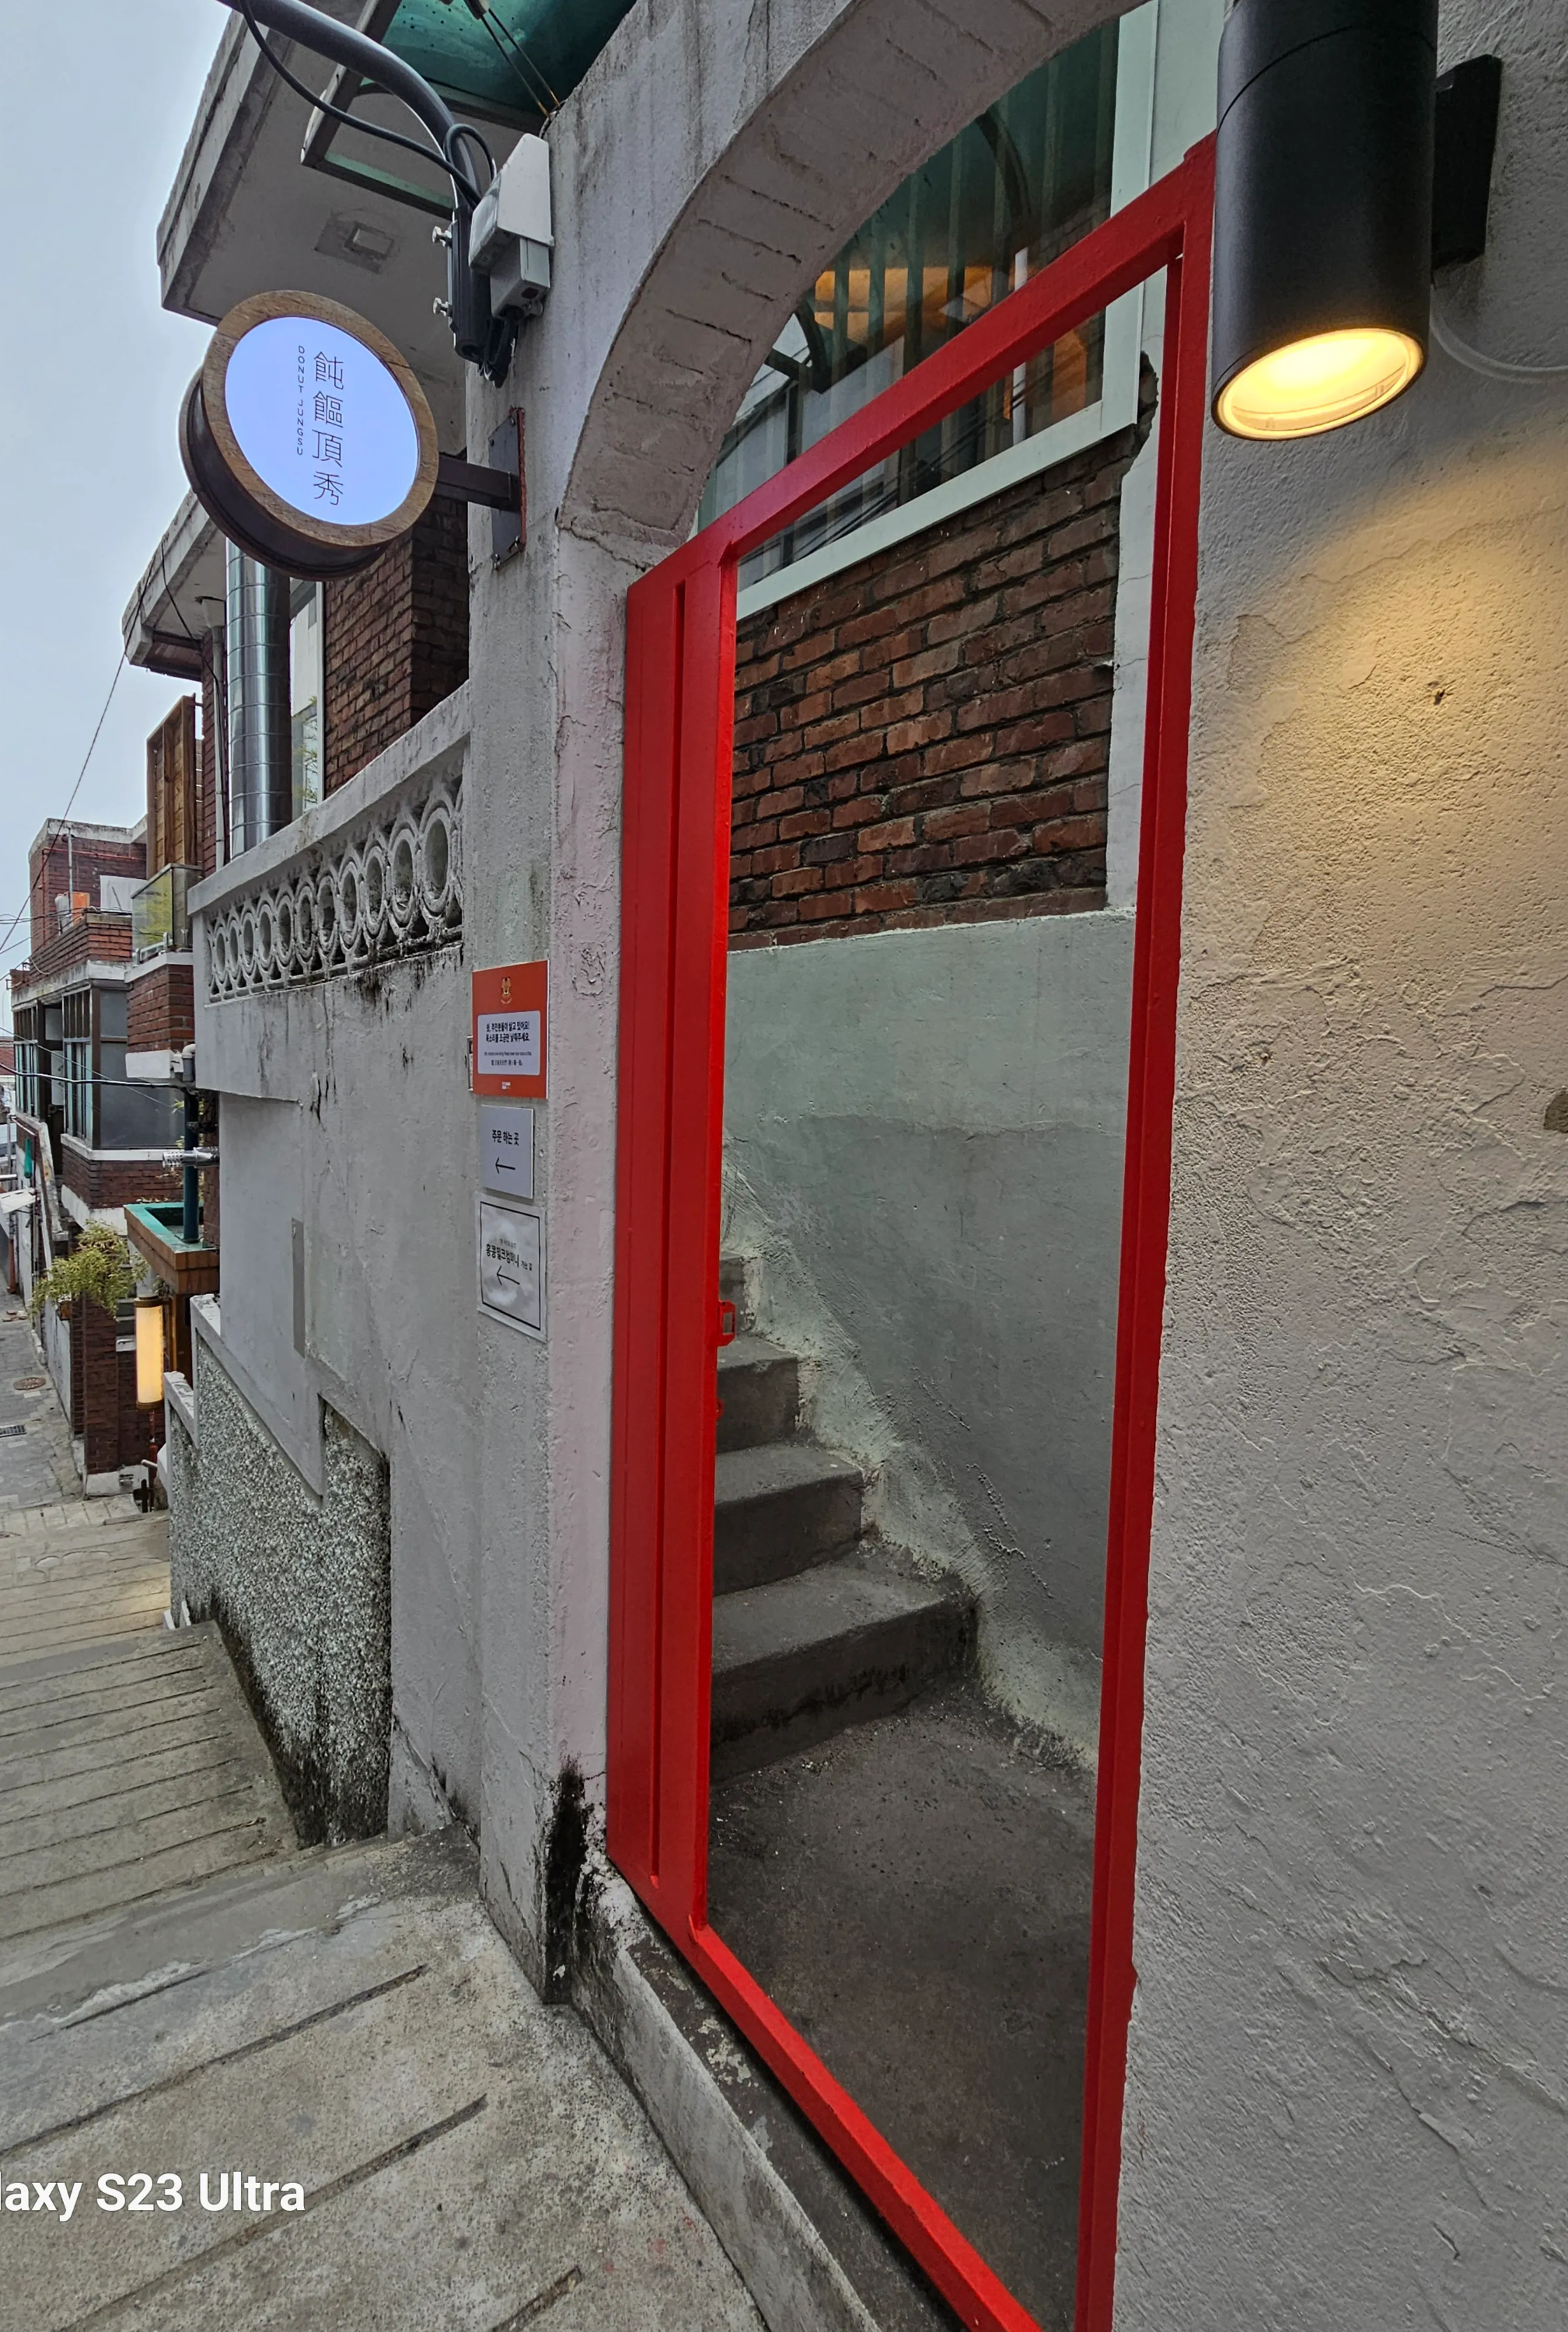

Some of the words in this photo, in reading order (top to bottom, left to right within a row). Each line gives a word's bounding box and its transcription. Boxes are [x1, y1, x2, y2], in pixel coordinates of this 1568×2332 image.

[297, 345, 306, 393] DONUT
[296, 399, 305, 456] JUNGSU
[509, 1021, 516, 1032] 살고
[492, 1129, 502, 1143] 주문
[503, 1130, 513, 1145] 하는
[514, 1132, 519, 1147] 곳
